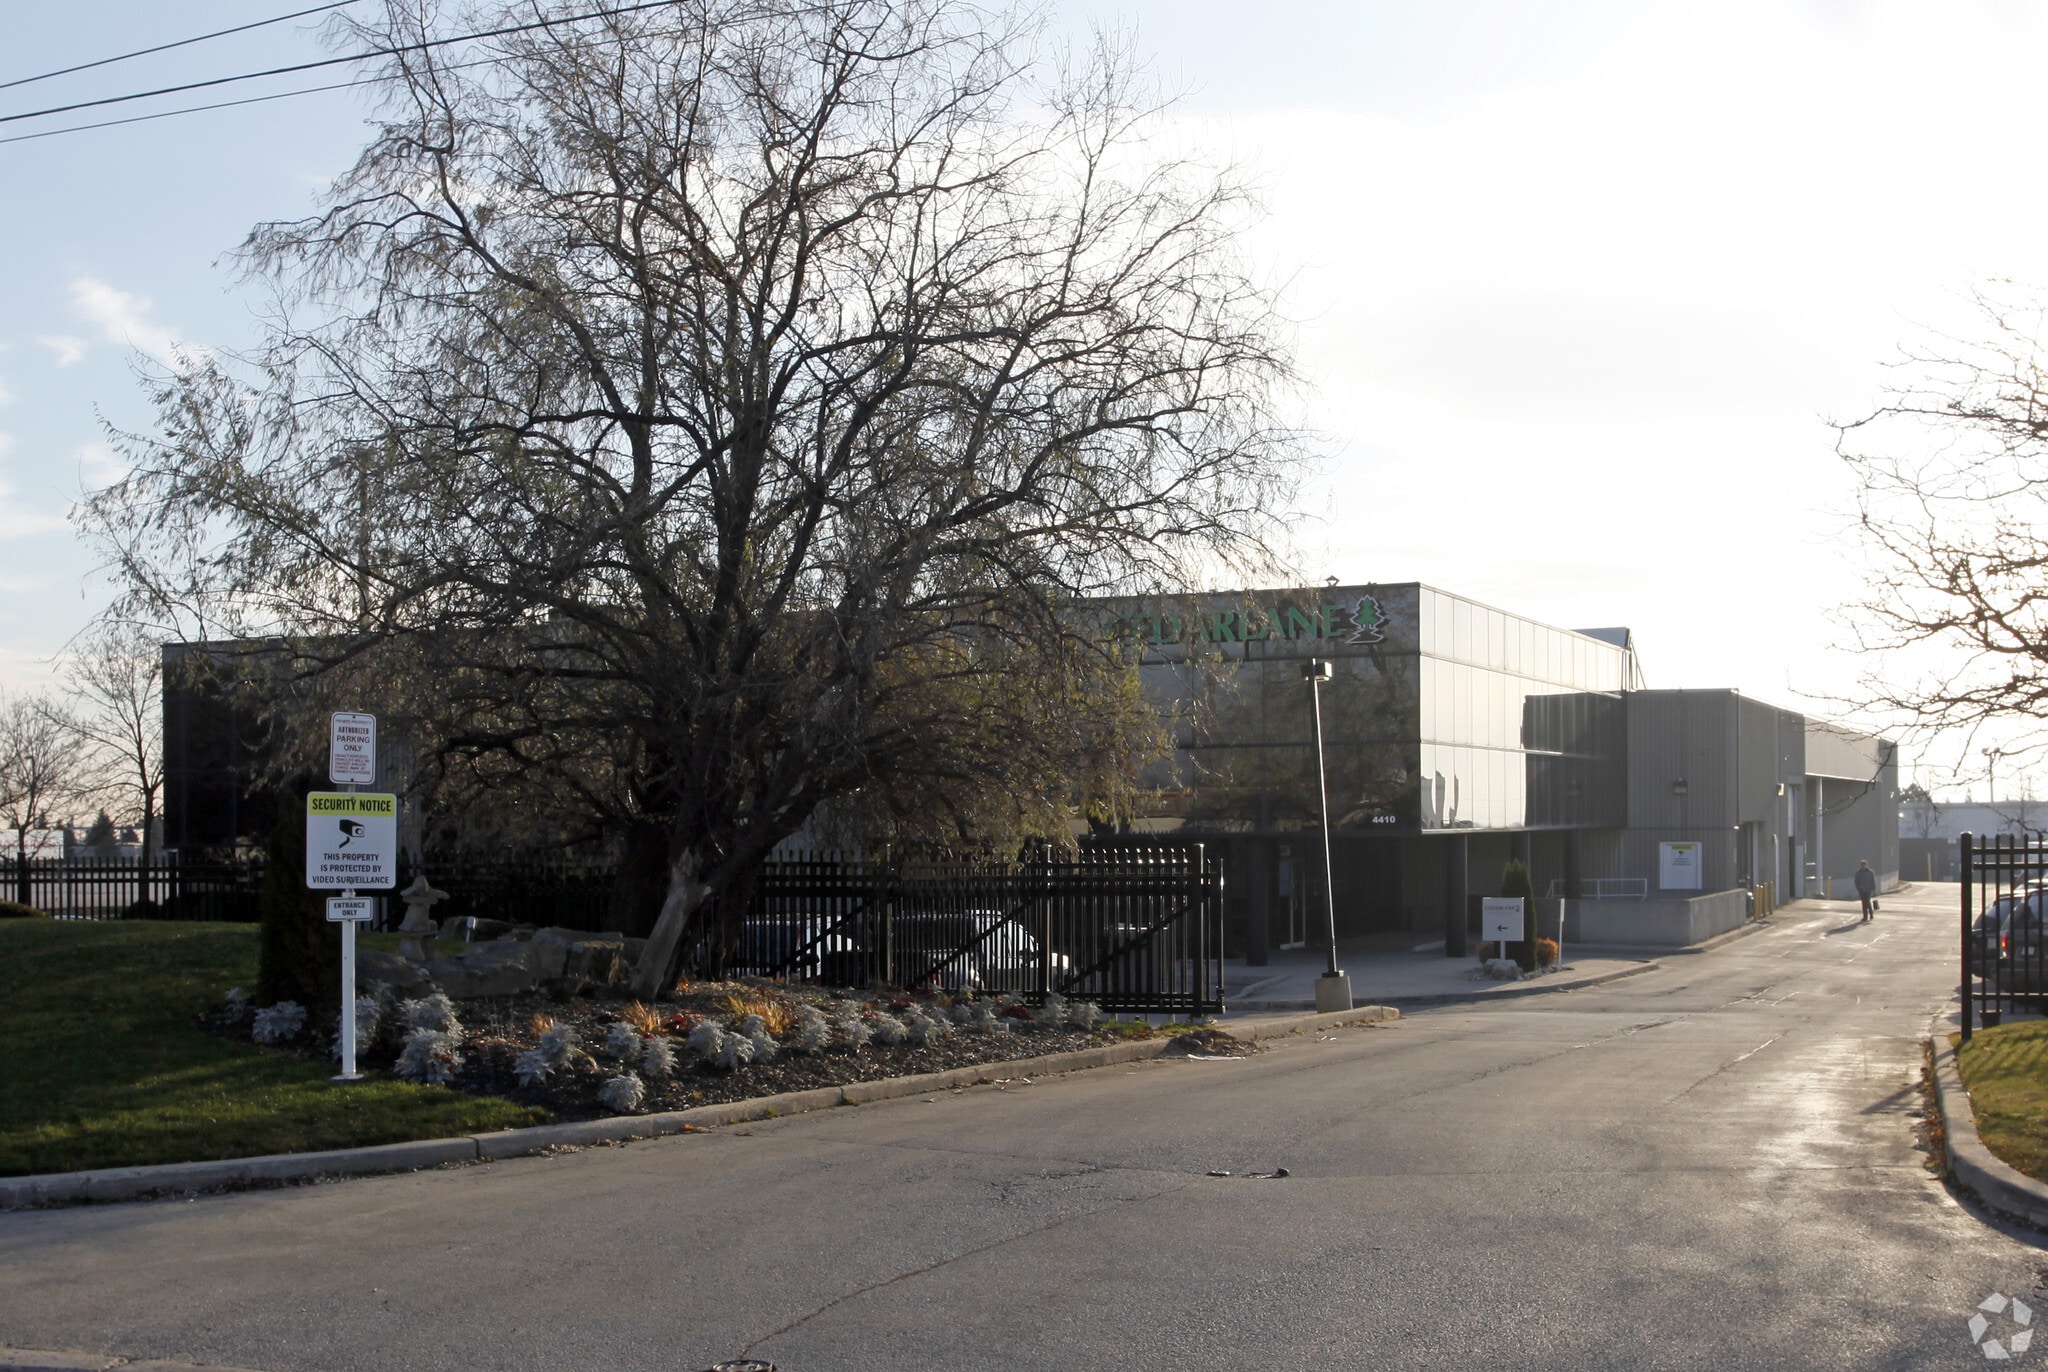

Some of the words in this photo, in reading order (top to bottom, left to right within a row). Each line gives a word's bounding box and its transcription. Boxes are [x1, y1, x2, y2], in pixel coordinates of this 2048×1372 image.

[338, 726, 369, 735] AUTHORIZED
[336, 735, 370, 743] PARKING
[343, 744, 362, 752] ONLY
[312, 798, 356, 811] SECURITY
[359, 800, 391, 812] NOTICE
[1372, 815, 1396, 823] 4410
[323, 853, 340, 861] THIS
[341, 853, 379, 862] PROPERTY
[320, 864, 328, 872] IS
[329, 864, 371, 873] PROTECTED
[372, 865, 382, 873] BY
[312, 875, 334, 884] VIDEO
[336, 875, 389, 884] SURVEILLANCE
[333, 901, 365, 909] ENTRANCE
